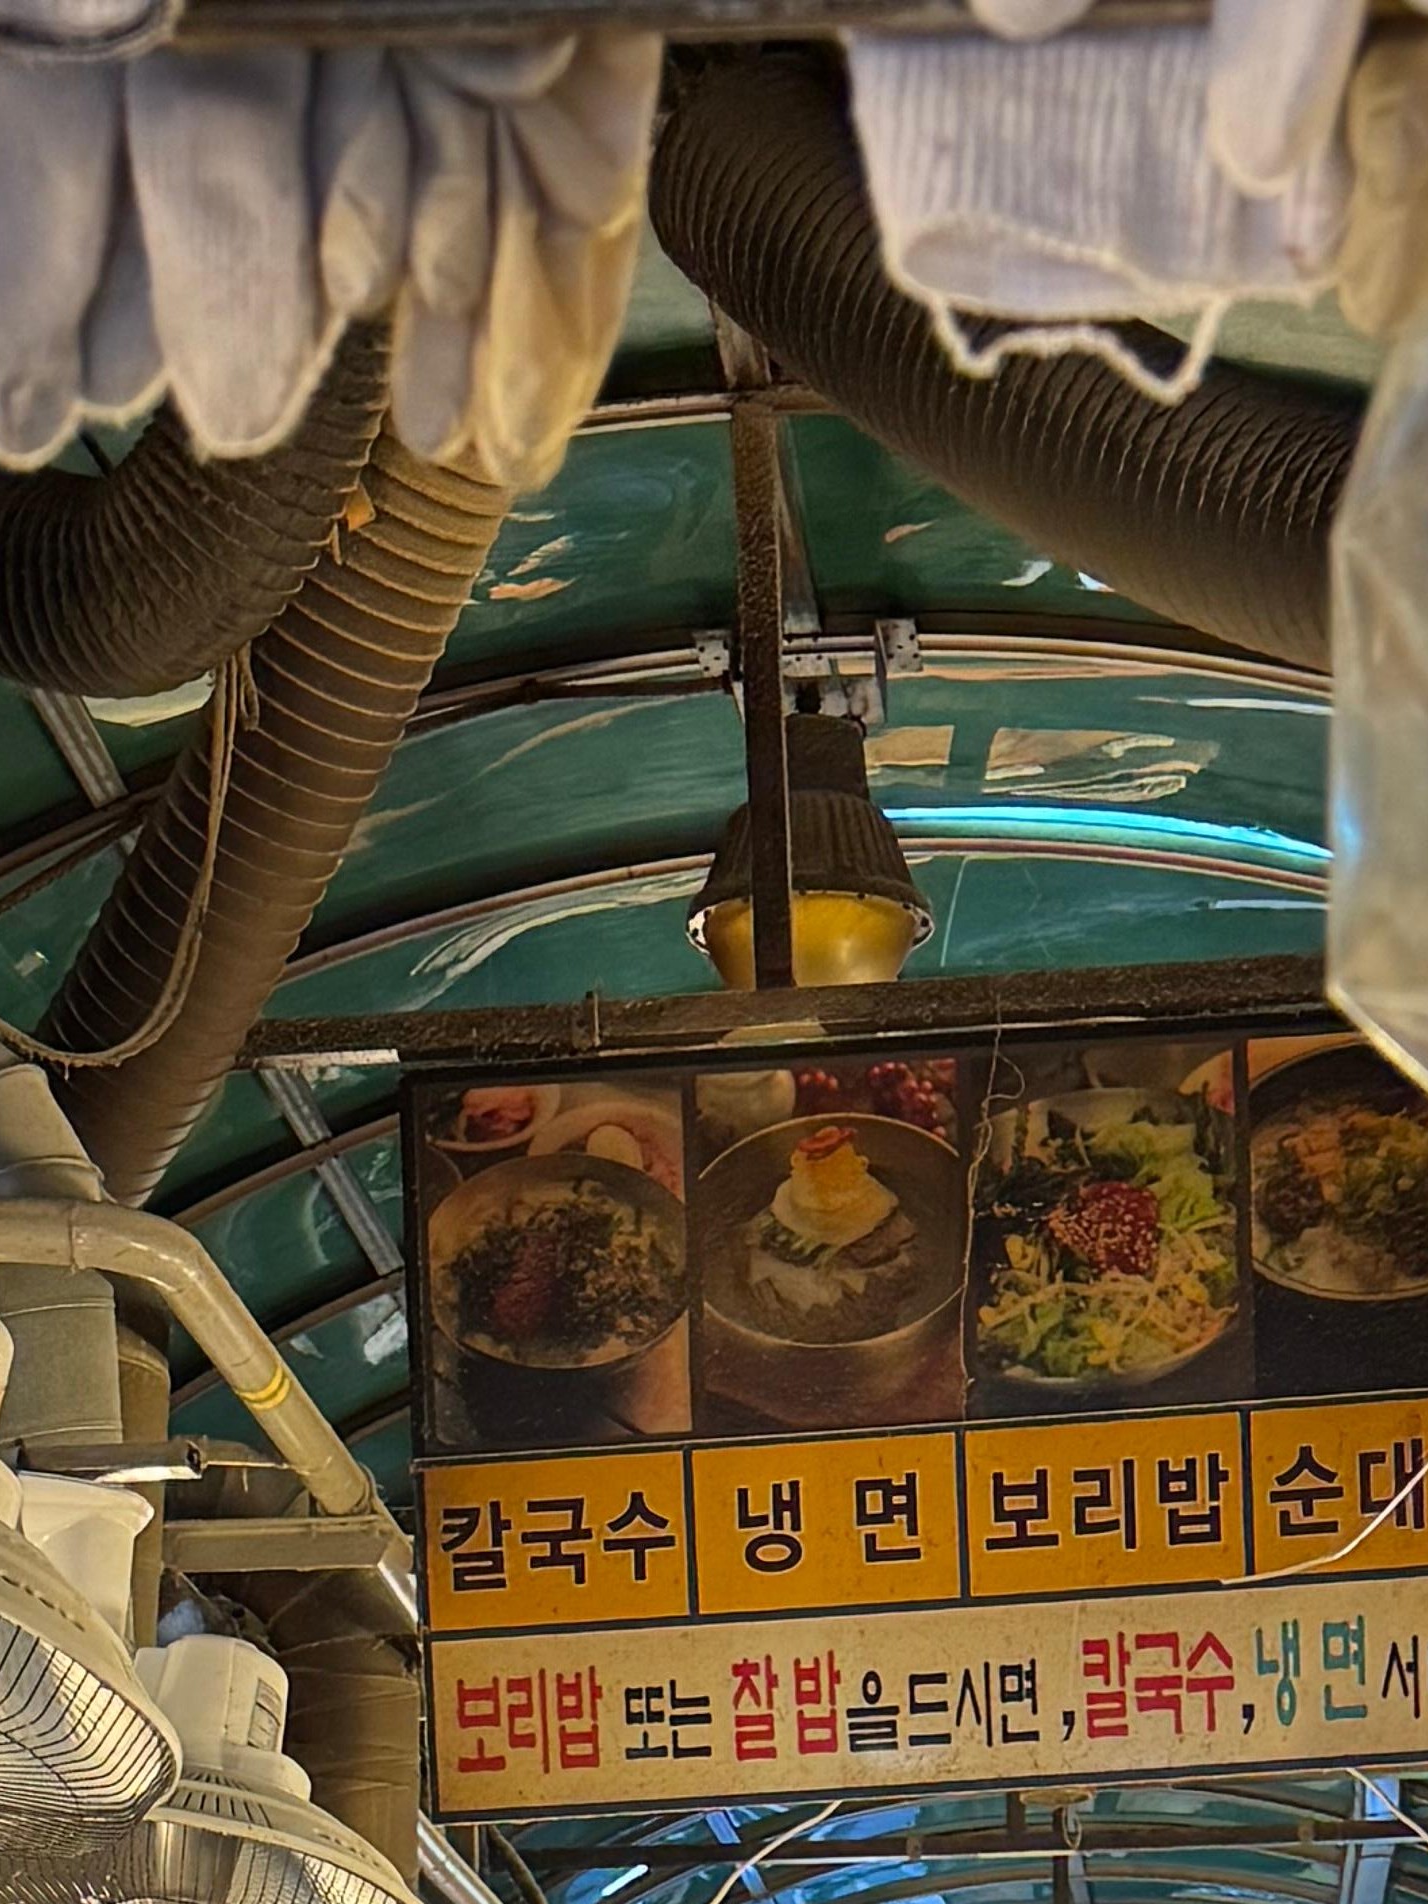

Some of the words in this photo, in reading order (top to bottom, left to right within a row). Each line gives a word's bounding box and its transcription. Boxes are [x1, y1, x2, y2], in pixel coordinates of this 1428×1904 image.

[439, 1489, 677, 1591] 칼국수
[985, 1452, 1231, 1555] 보리밥
[456, 1666, 602, 1774] 보리밥
[624, 1678, 712, 1762] 또는
